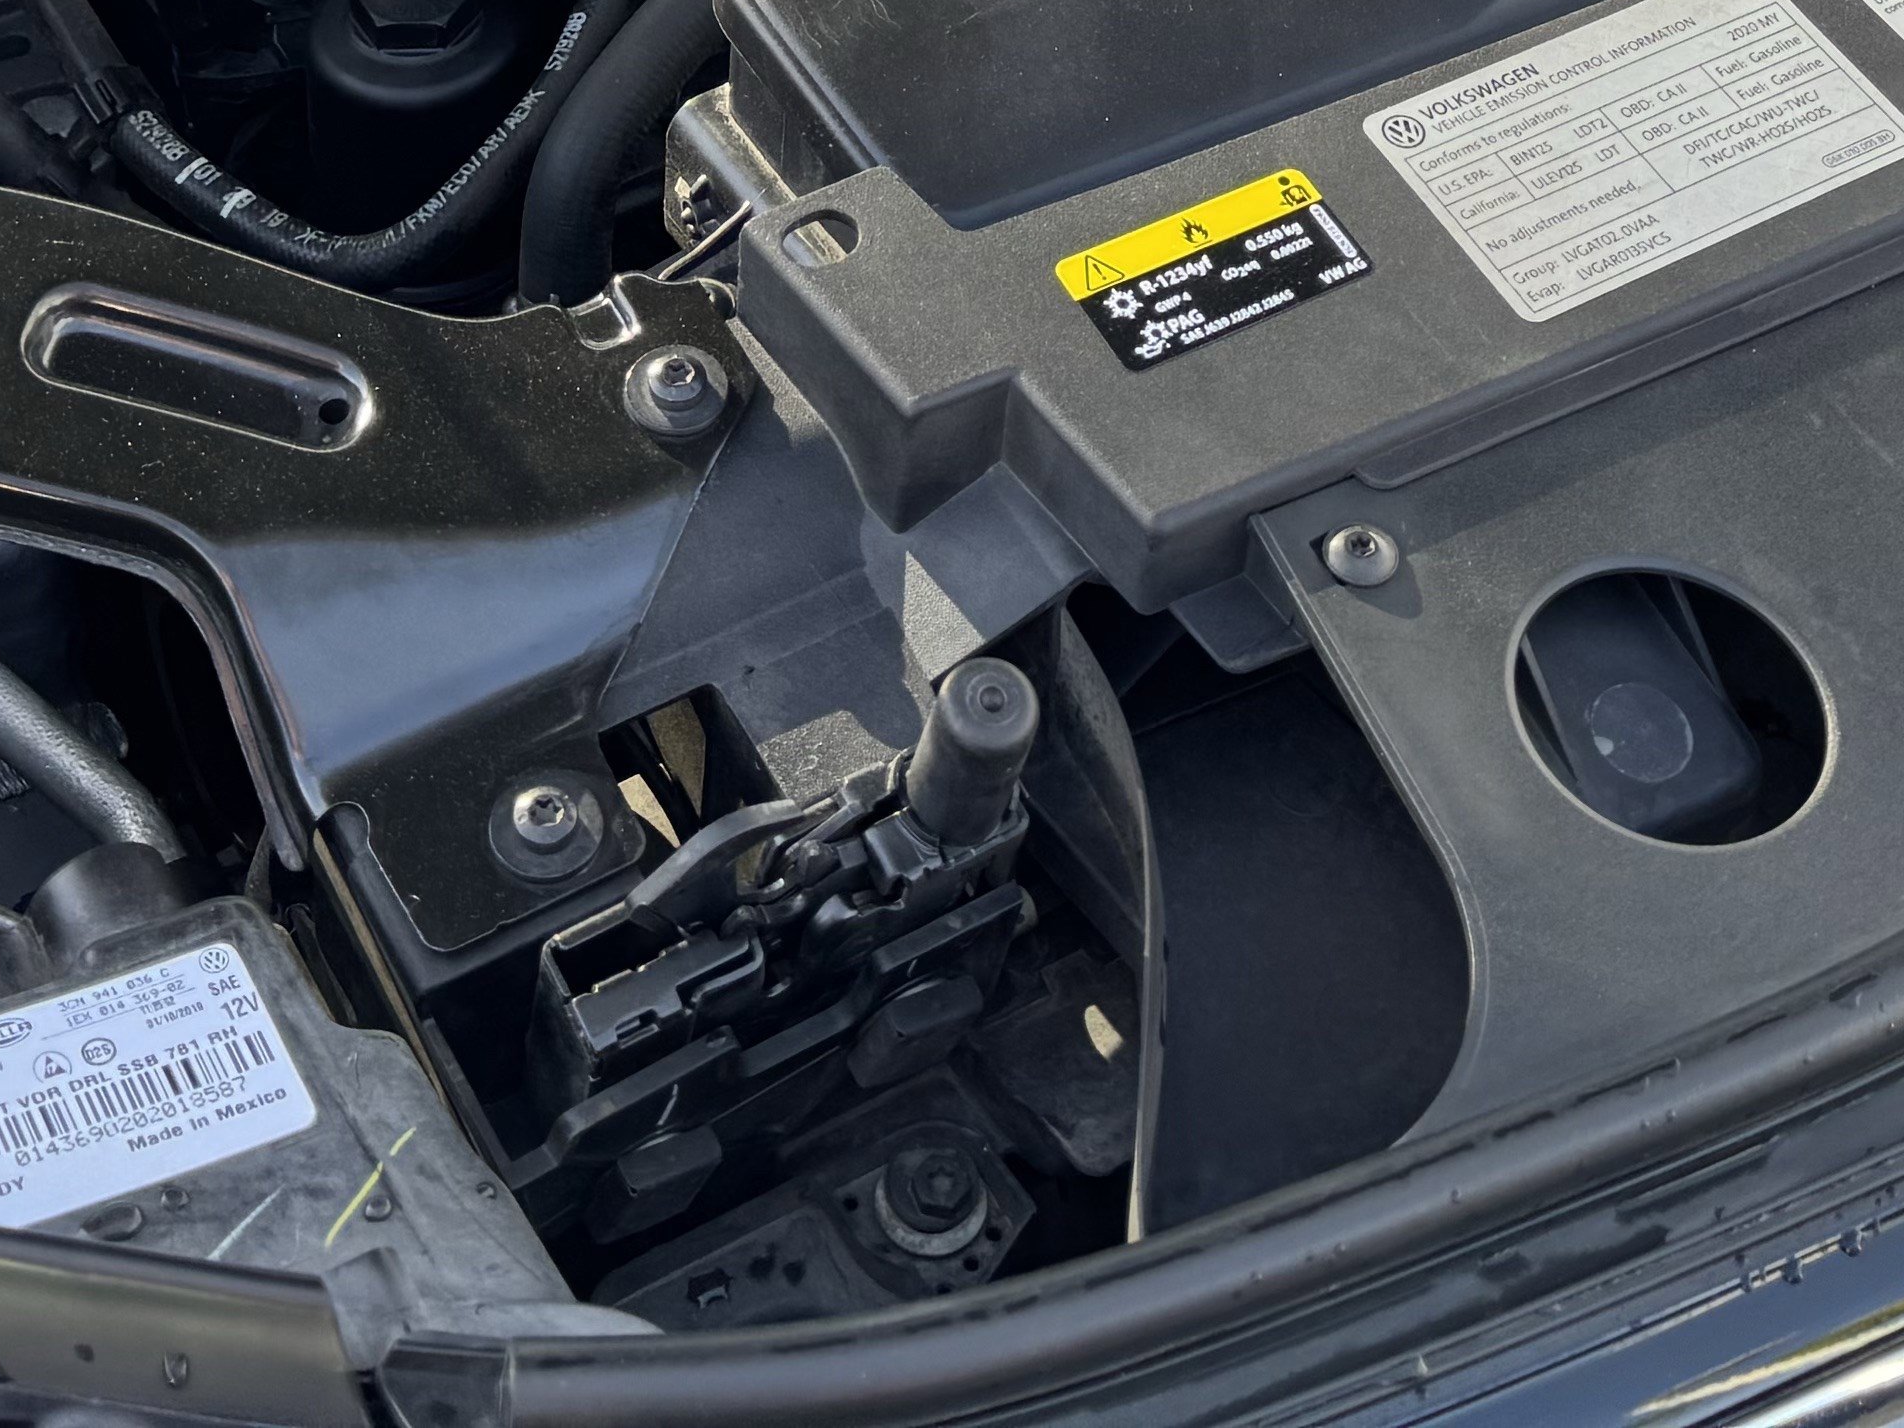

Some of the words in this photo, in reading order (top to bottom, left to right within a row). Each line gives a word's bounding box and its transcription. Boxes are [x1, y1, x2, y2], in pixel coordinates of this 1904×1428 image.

[1726, 21, 1758, 41] 2020
[1756, 12, 1779, 28] MY
[1714, 59, 1747, 77] Fuel:
[1748, 36, 1801, 63] Gasoline
[1431, 105, 1486, 133] VEHICLE
[1485, 79, 1548, 111] EMISSION
[1548, 54, 1609, 84] CONTROL
[1608, 17, 1695, 58] INFORMATION
[1735, 81, 1769, 100] Fuel:
[1770, 59, 1824, 85] Gasoline
[1419, 64, 1538, 118] VOLKSWAGEN
[1619, 99, 1654, 118] OBD:
[1656, 88, 1678, 102] CA
[1419, 141, 1481, 171] Conforms
[1479, 134, 1497, 146] to
[1498, 104, 1569, 138] regulations:
[1572, 117, 1607, 138] LDT2
[1641, 122, 1676, 141] OBD:
[1677, 111, 1699, 125] CA
[1509, 141, 1553, 165] BIN125
[1594, 143, 1620, 162] LDT
[1437, 179, 1465, 195] U.S.
[1462, 168, 1493, 185] EPA:
[1530, 160, 1582, 189] ULEV125
[1459, 191, 1519, 219] California:
[1244, 228, 1283, 251] 0.550
[1280, 221, 1303, 236] kg
[1484, 238, 1508, 252] No
[1509, 204, 1588, 242] adjustments
[1139, 254, 1212, 295] R-1234yf
[1318, 265, 1345, 284] VW
[1344, 256, 1367, 274] AG
[1512, 260, 1559, 284] Group:
[1154, 294, 1181, 312] GWP
[1178, 290, 1192, 301] 4
[1526, 282, 1565, 302] Evap:
[1166, 308, 1205, 333] PAG
[1179, 326, 1205, 344] SAE
[159, 967, 170, 978] C
[207, 974, 240, 996] SAE
[220, 991, 258, 1020] 12V
[16, 1086, 61, 1108] VOR
[68, 1071, 111, 1092] DRL
[164, 1038, 199, 1059] 781
[206, 1025, 237, 1044] RH
[127, 1125, 182, 1151] Made
[215, 1088, 286, 1120] Mexico
